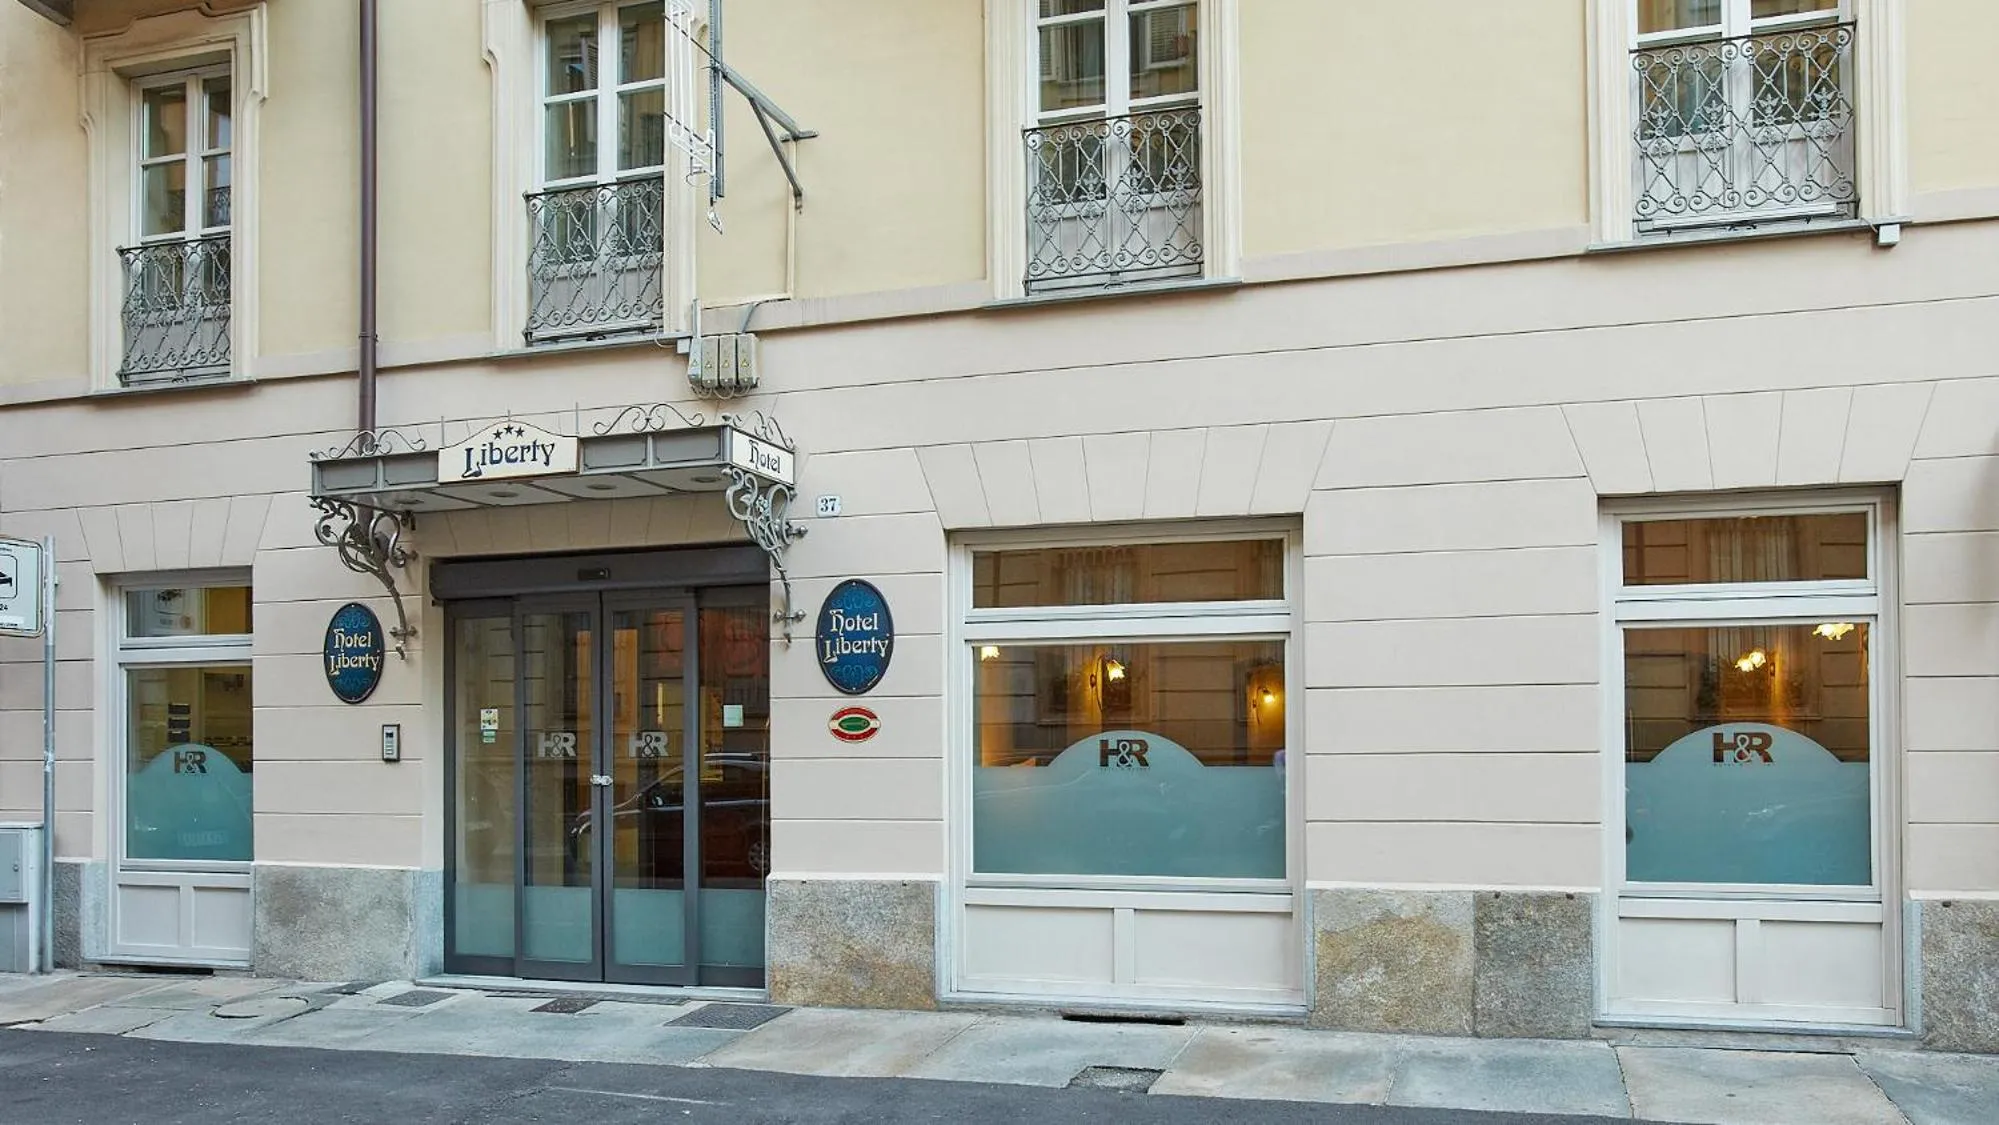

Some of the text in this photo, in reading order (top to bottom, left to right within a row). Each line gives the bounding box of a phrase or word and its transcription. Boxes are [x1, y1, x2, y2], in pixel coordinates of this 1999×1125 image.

[461, 438, 555, 478] Liberty
[820, 498, 837, 512] 37
[823, 636, 889, 663] Liberty
[328, 653, 380, 675] Liberty
[537, 732, 577, 757] H&R
[628, 731, 669, 757] H&R
[1099, 739, 1150, 767] H&R
[1713, 732, 1774, 763] H&R
[174, 751, 207, 774] H&R
